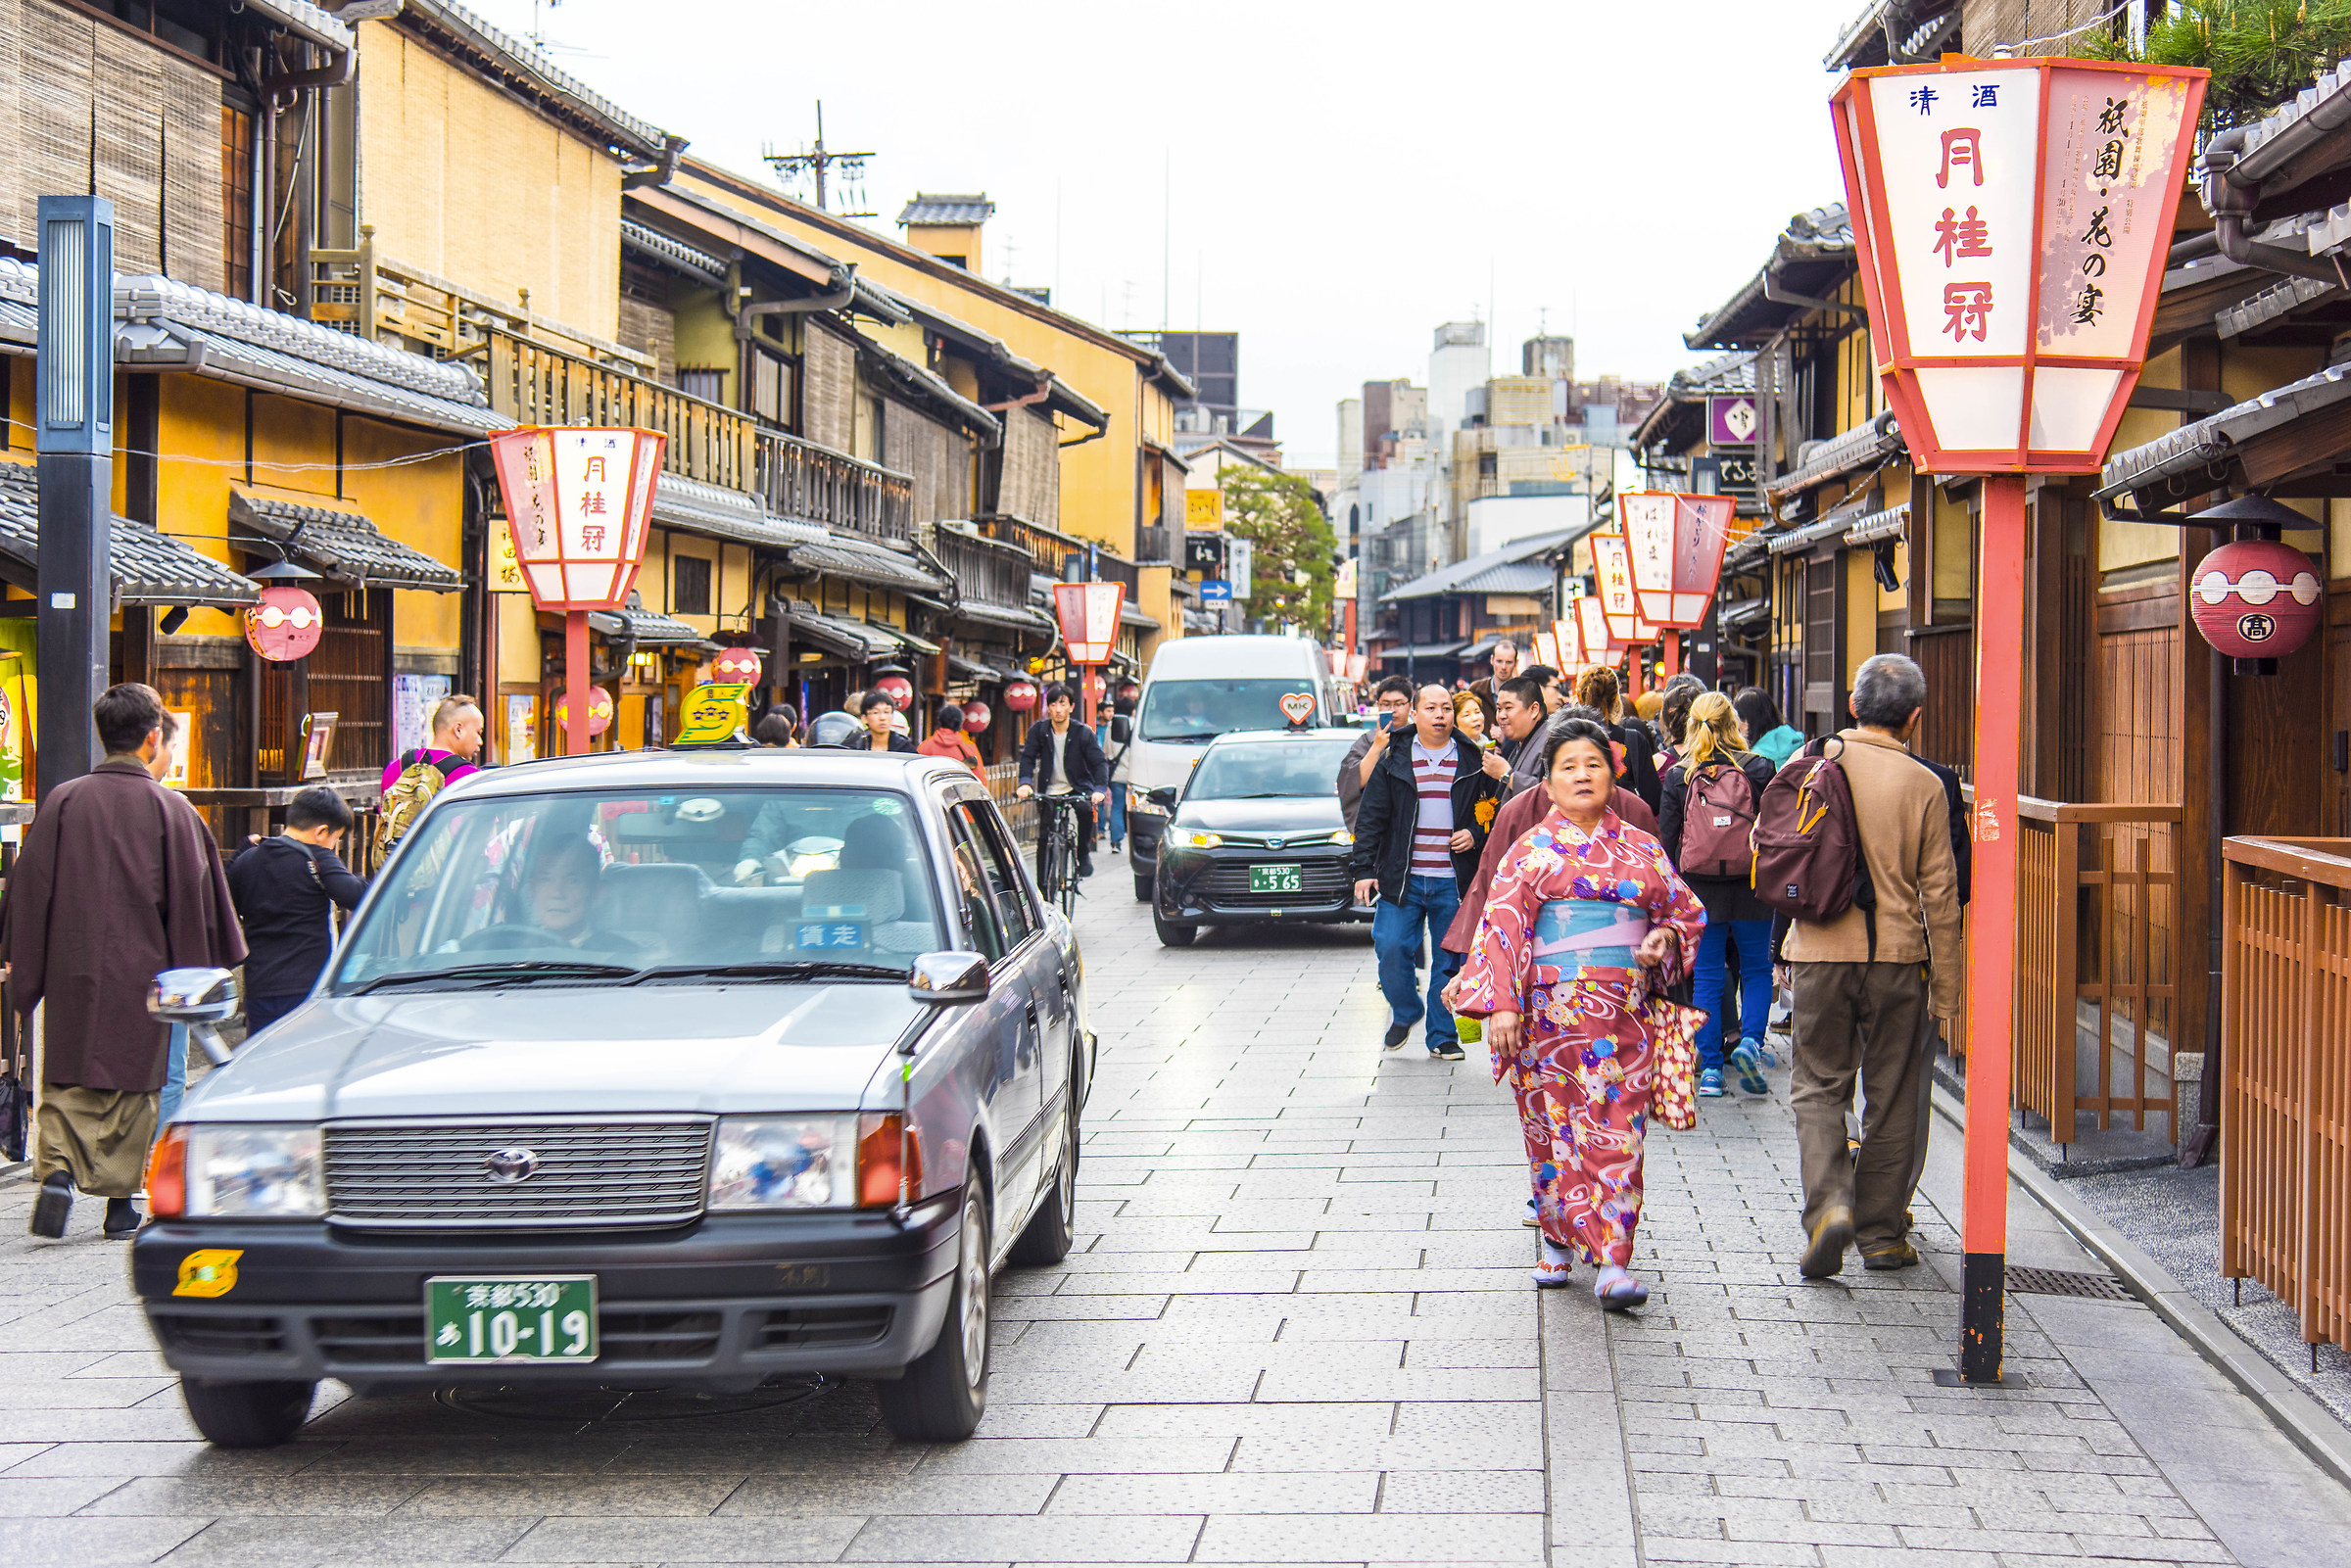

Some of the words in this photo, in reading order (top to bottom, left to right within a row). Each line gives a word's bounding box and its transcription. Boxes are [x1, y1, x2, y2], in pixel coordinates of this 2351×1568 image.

[1909, 84, 2000, 116] 清酒
[1932, 126, 1994, 343] 月桂冠
[2069, 96, 2130, 327] 祇園・花の宴
[580, 455, 607, 552] 月桂冠
[464, 1282, 560, 1309] 京都530
[468, 1309, 589, 1357] 10-19
